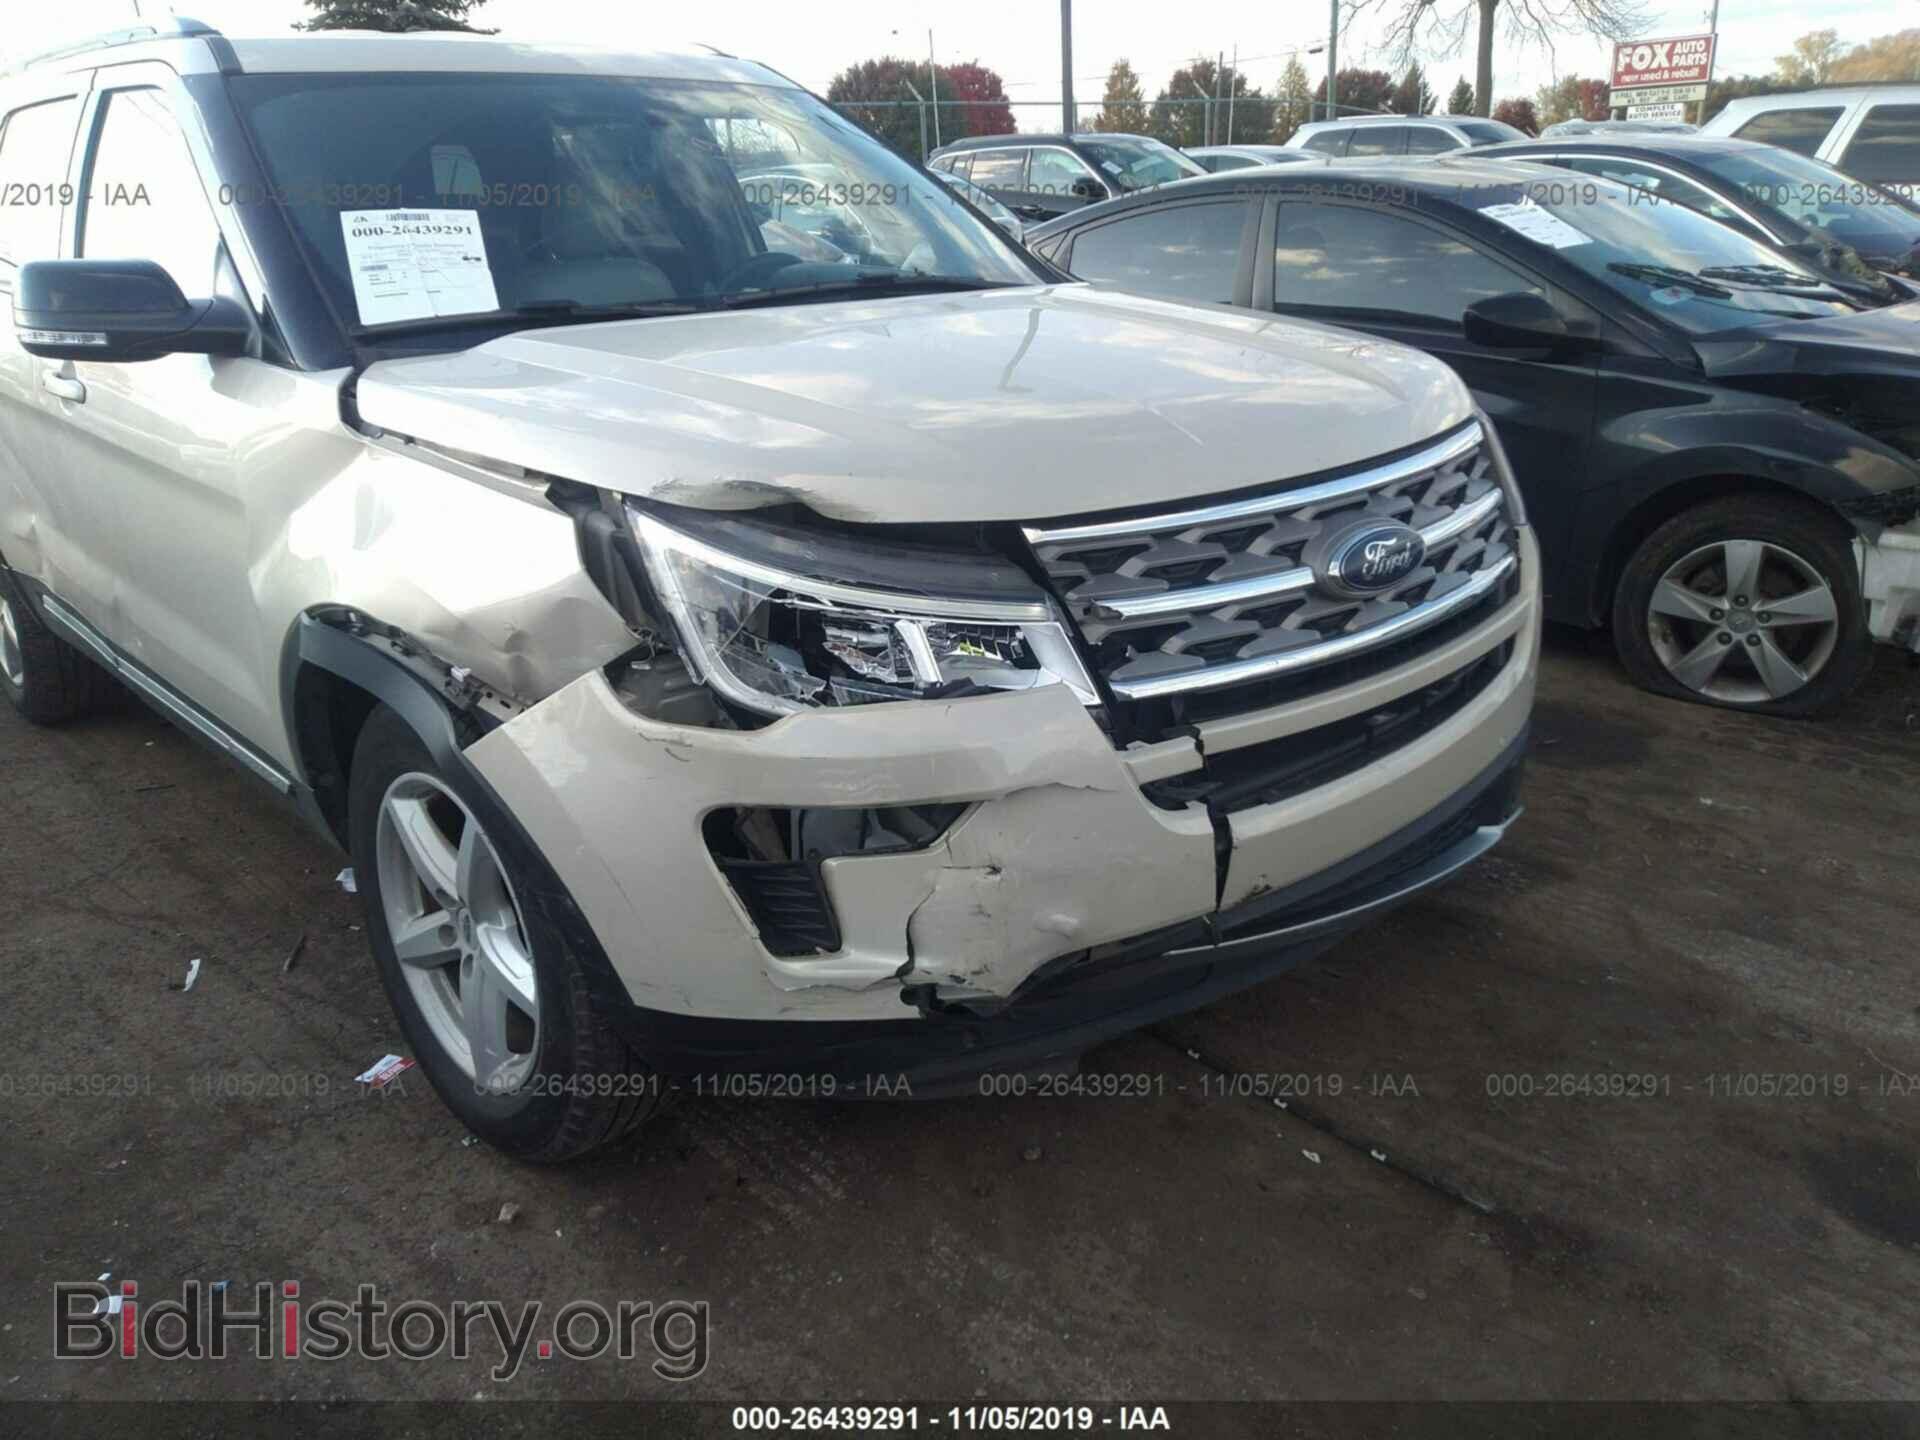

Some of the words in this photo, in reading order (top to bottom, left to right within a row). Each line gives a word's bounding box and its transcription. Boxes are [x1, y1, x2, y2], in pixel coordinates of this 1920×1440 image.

[1673, 40, 1706, 53] AUTO
[1617, 43, 1672, 72] FOX
[1672, 53, 1708, 66] PARTS
[1640, 70, 1662, 81] used
[1663, 69, 1671, 79] &
[1671, 66, 1700, 78] rebuilt
[351, 224, 473, 238] 000-26439291
[1362, 537, 1413, 576] Ford
